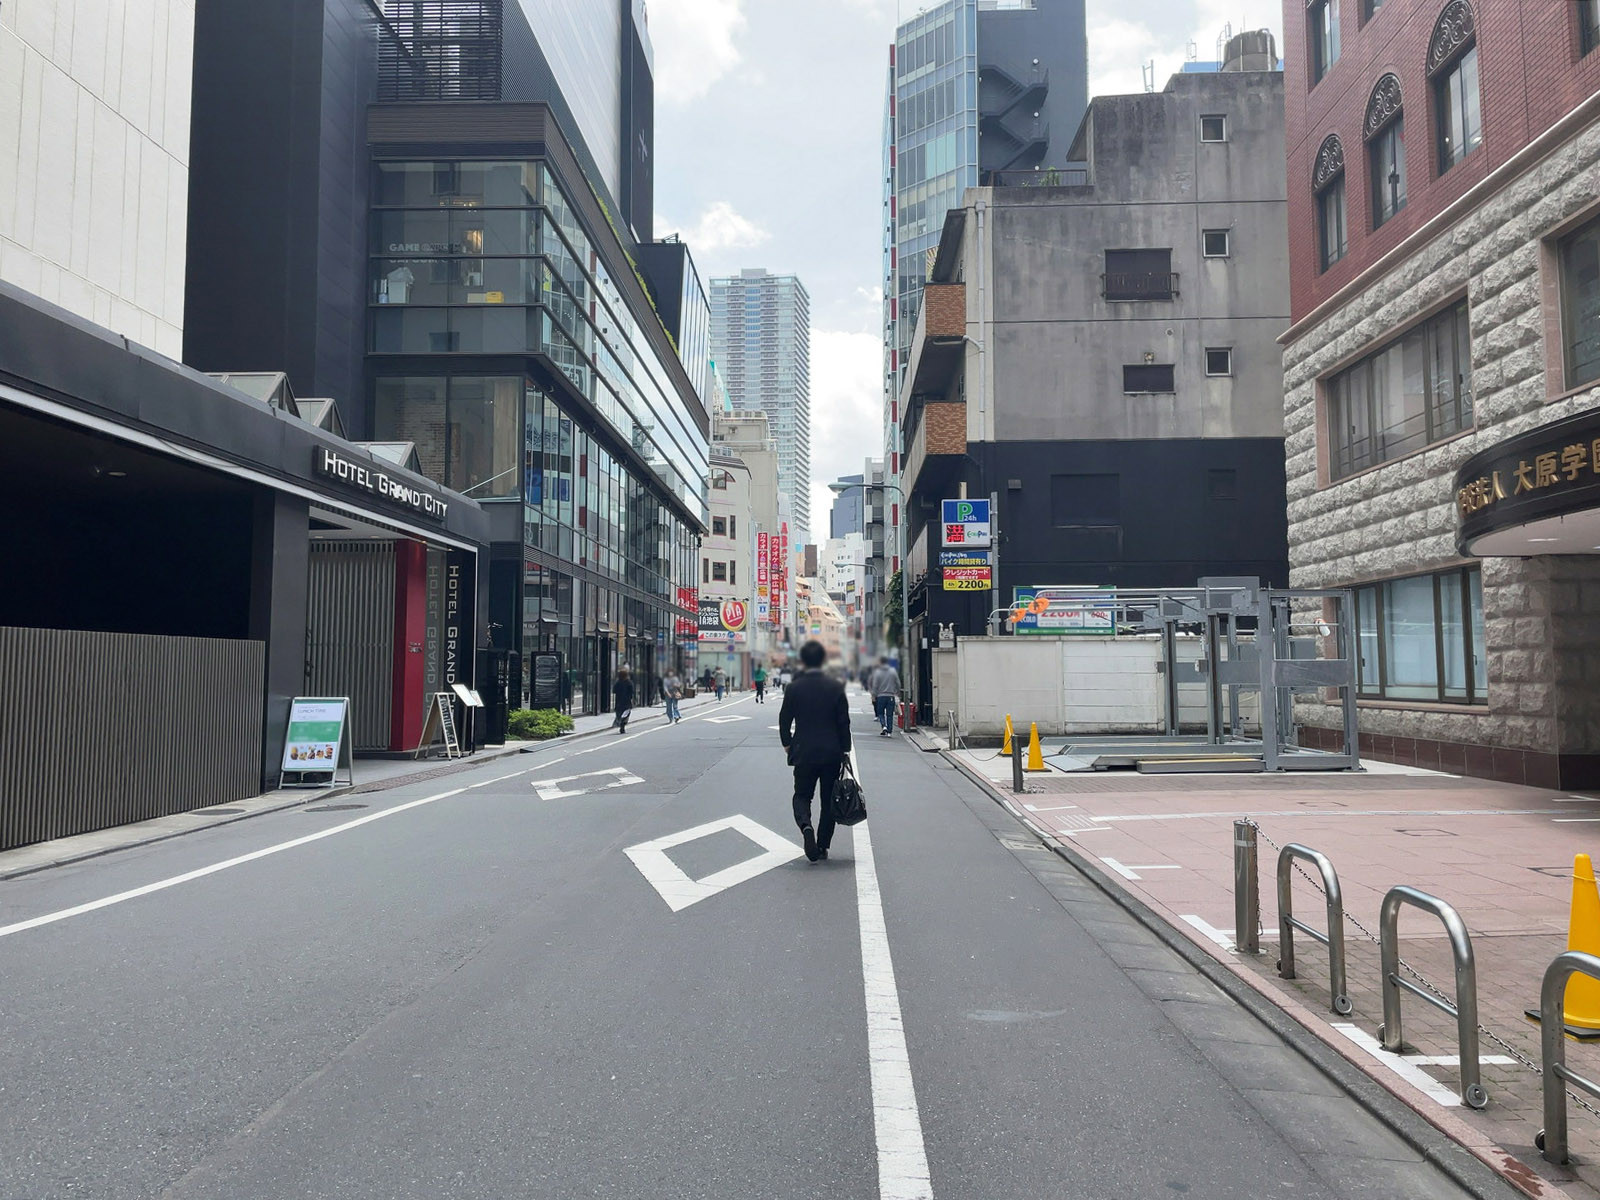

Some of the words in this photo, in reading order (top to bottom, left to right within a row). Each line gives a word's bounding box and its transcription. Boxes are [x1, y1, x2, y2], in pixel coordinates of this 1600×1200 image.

[389, 243, 420, 252] GAME
[1513, 438, 1600, 495] 大原学
[324, 450, 373, 488] HOTEL
[373, 473, 420, 507] GRAND
[420, 493, 448, 517] CITY
[957, 502, 973, 522] P
[771, 538, 779, 563] カラオケ
[448, 565, 459, 619] HOTEL
[958, 580, 989, 589] 2200円
[726, 604, 742, 620] PIA
[447, 626, 458, 684] GRAND
